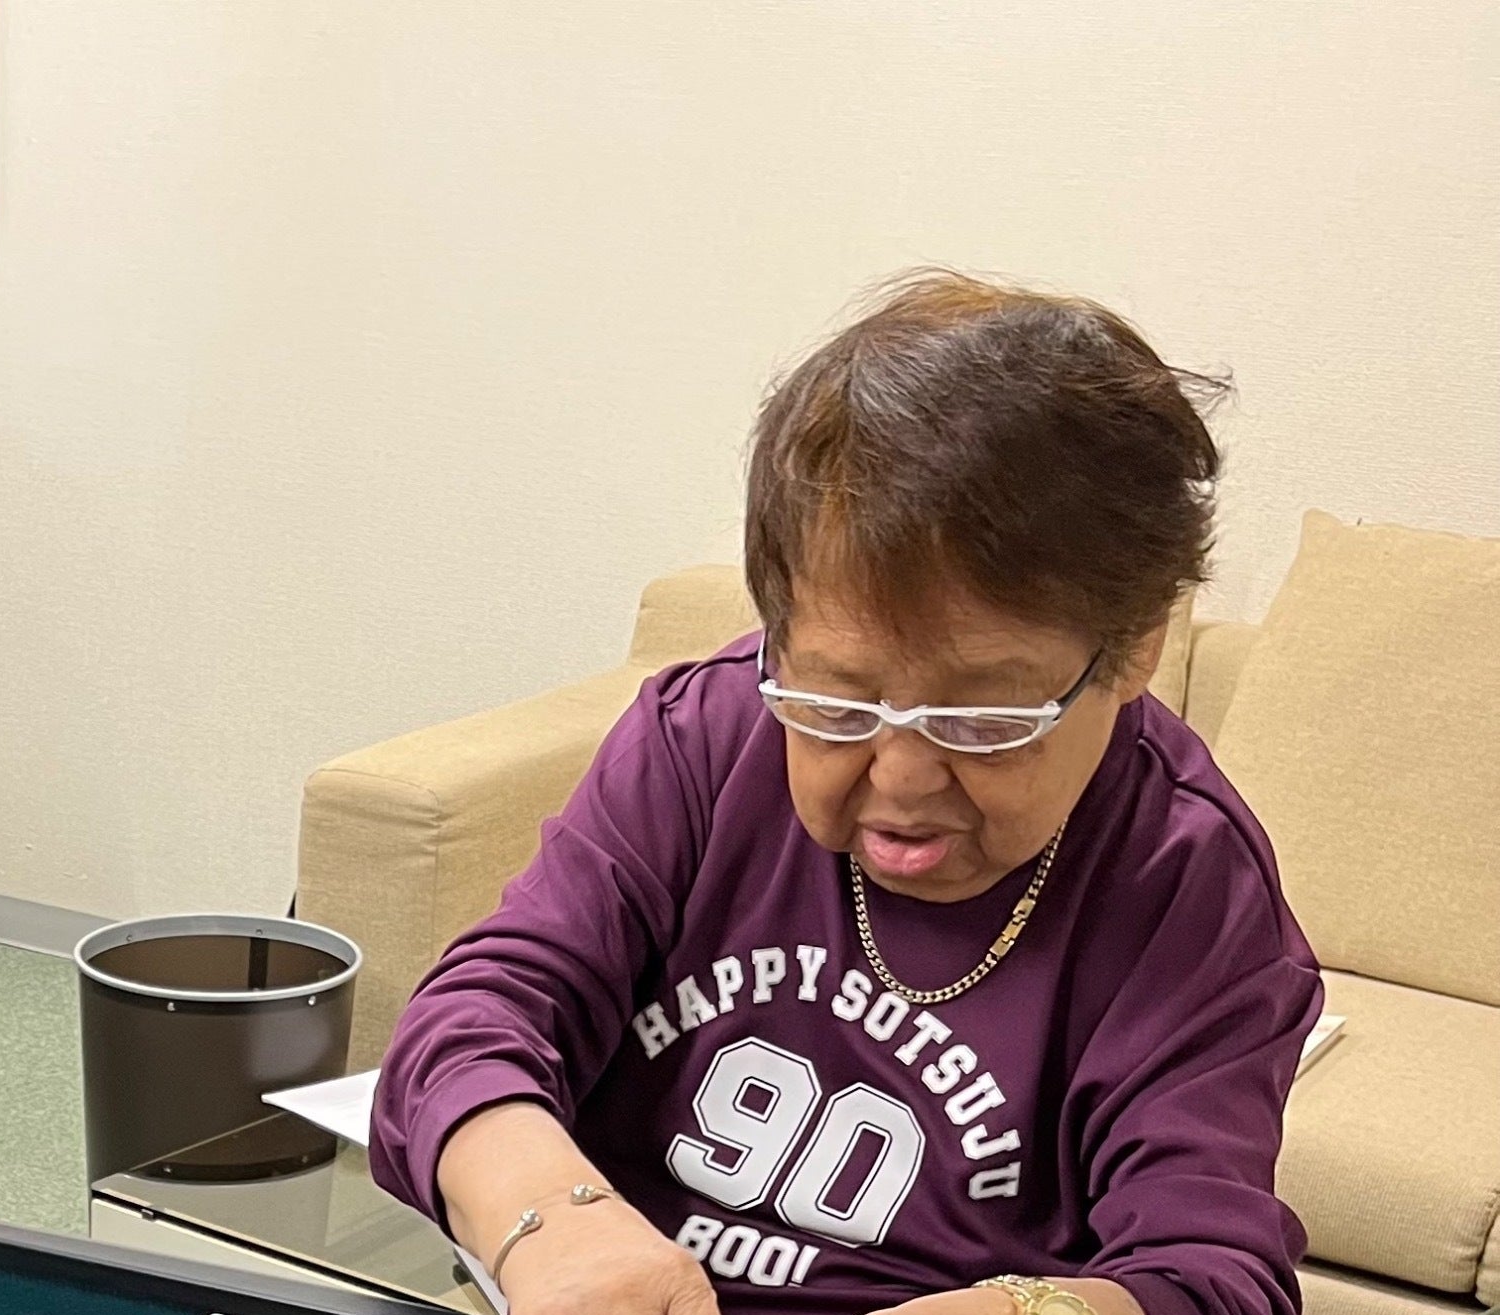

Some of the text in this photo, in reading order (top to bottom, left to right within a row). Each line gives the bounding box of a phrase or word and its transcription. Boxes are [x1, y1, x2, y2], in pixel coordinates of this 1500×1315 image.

[631, 944, 1022, 1201] HAPPY SOTSUJU
[665, 1036, 927, 1249] 90
